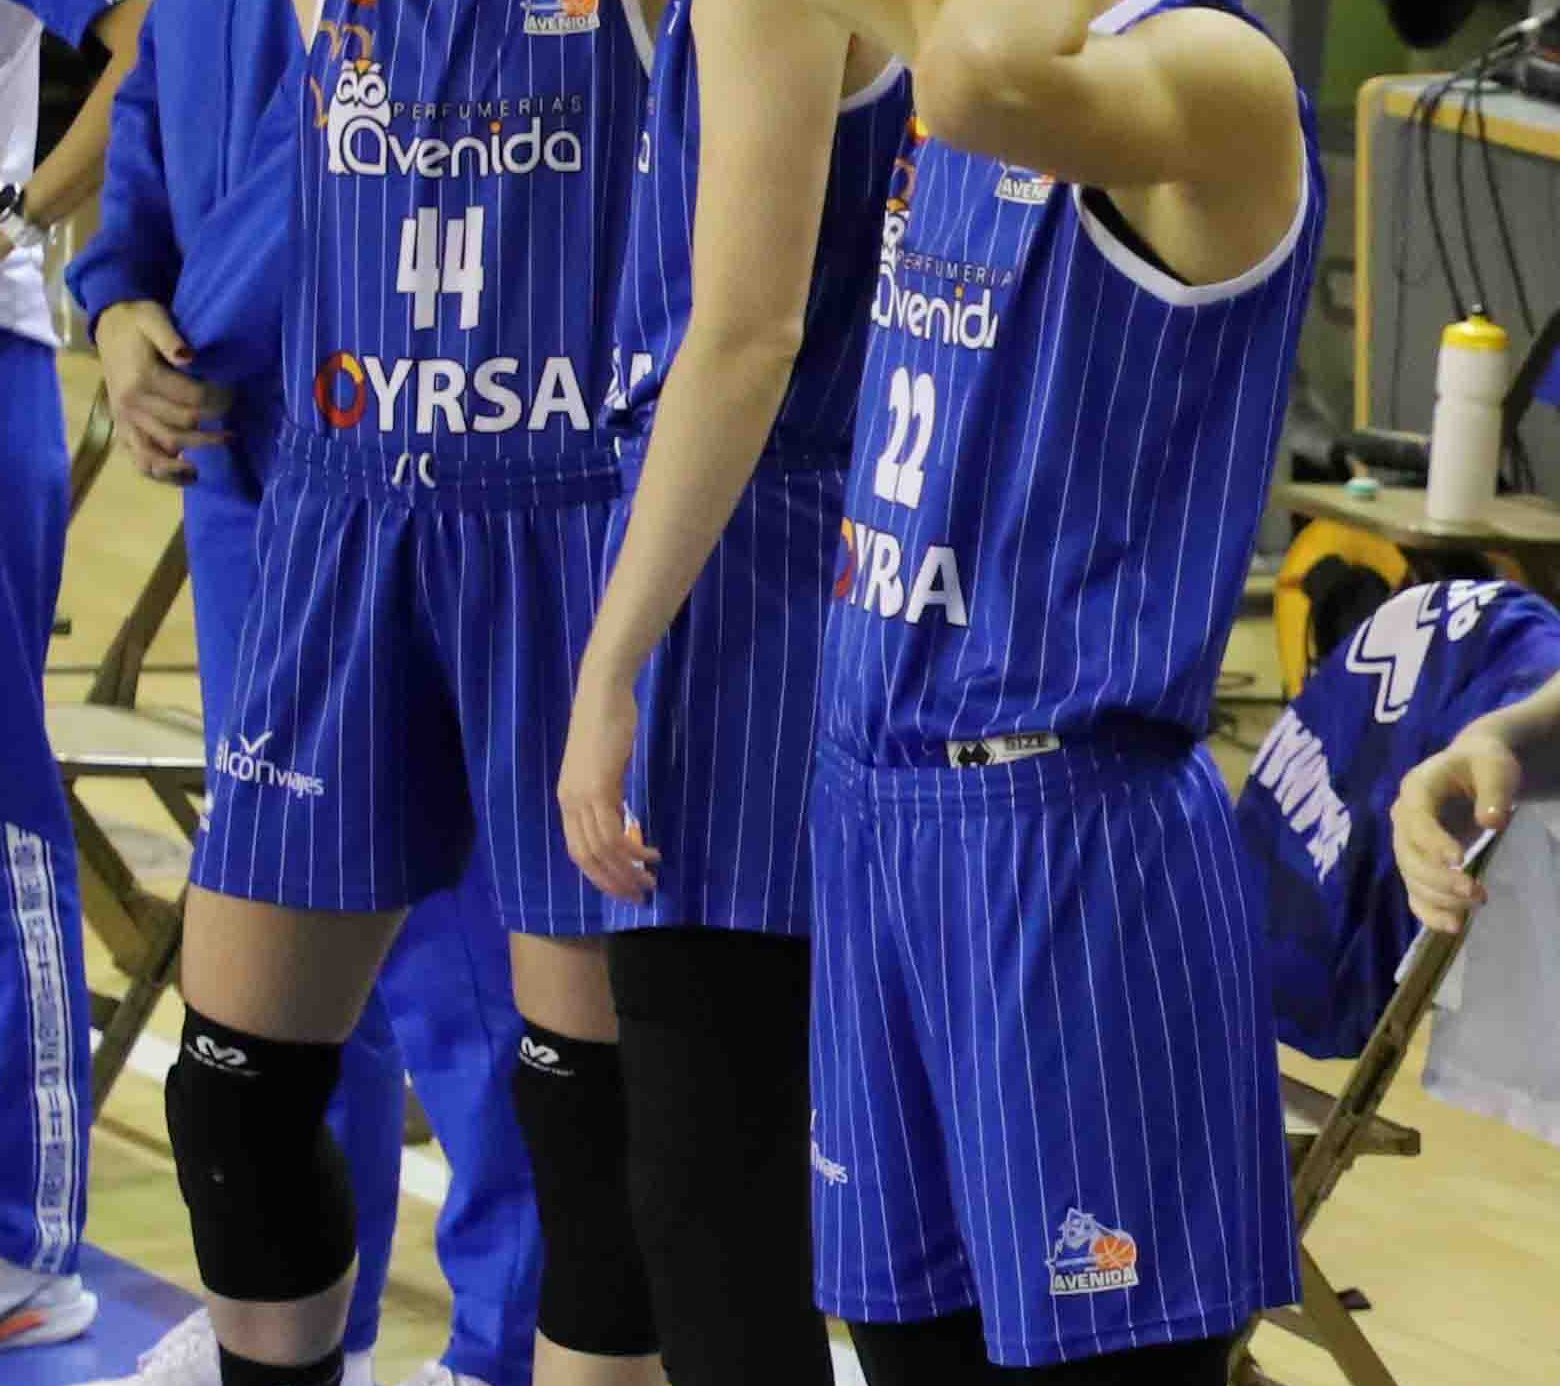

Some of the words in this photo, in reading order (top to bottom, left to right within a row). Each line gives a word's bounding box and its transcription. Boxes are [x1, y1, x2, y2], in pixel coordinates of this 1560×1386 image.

[1000, 176, 1050, 199] AVEN
[396, 206, 485, 331] 44
[873, 365, 936, 509] 22
[1052, 1268, 1138, 1291] AVENIDA
